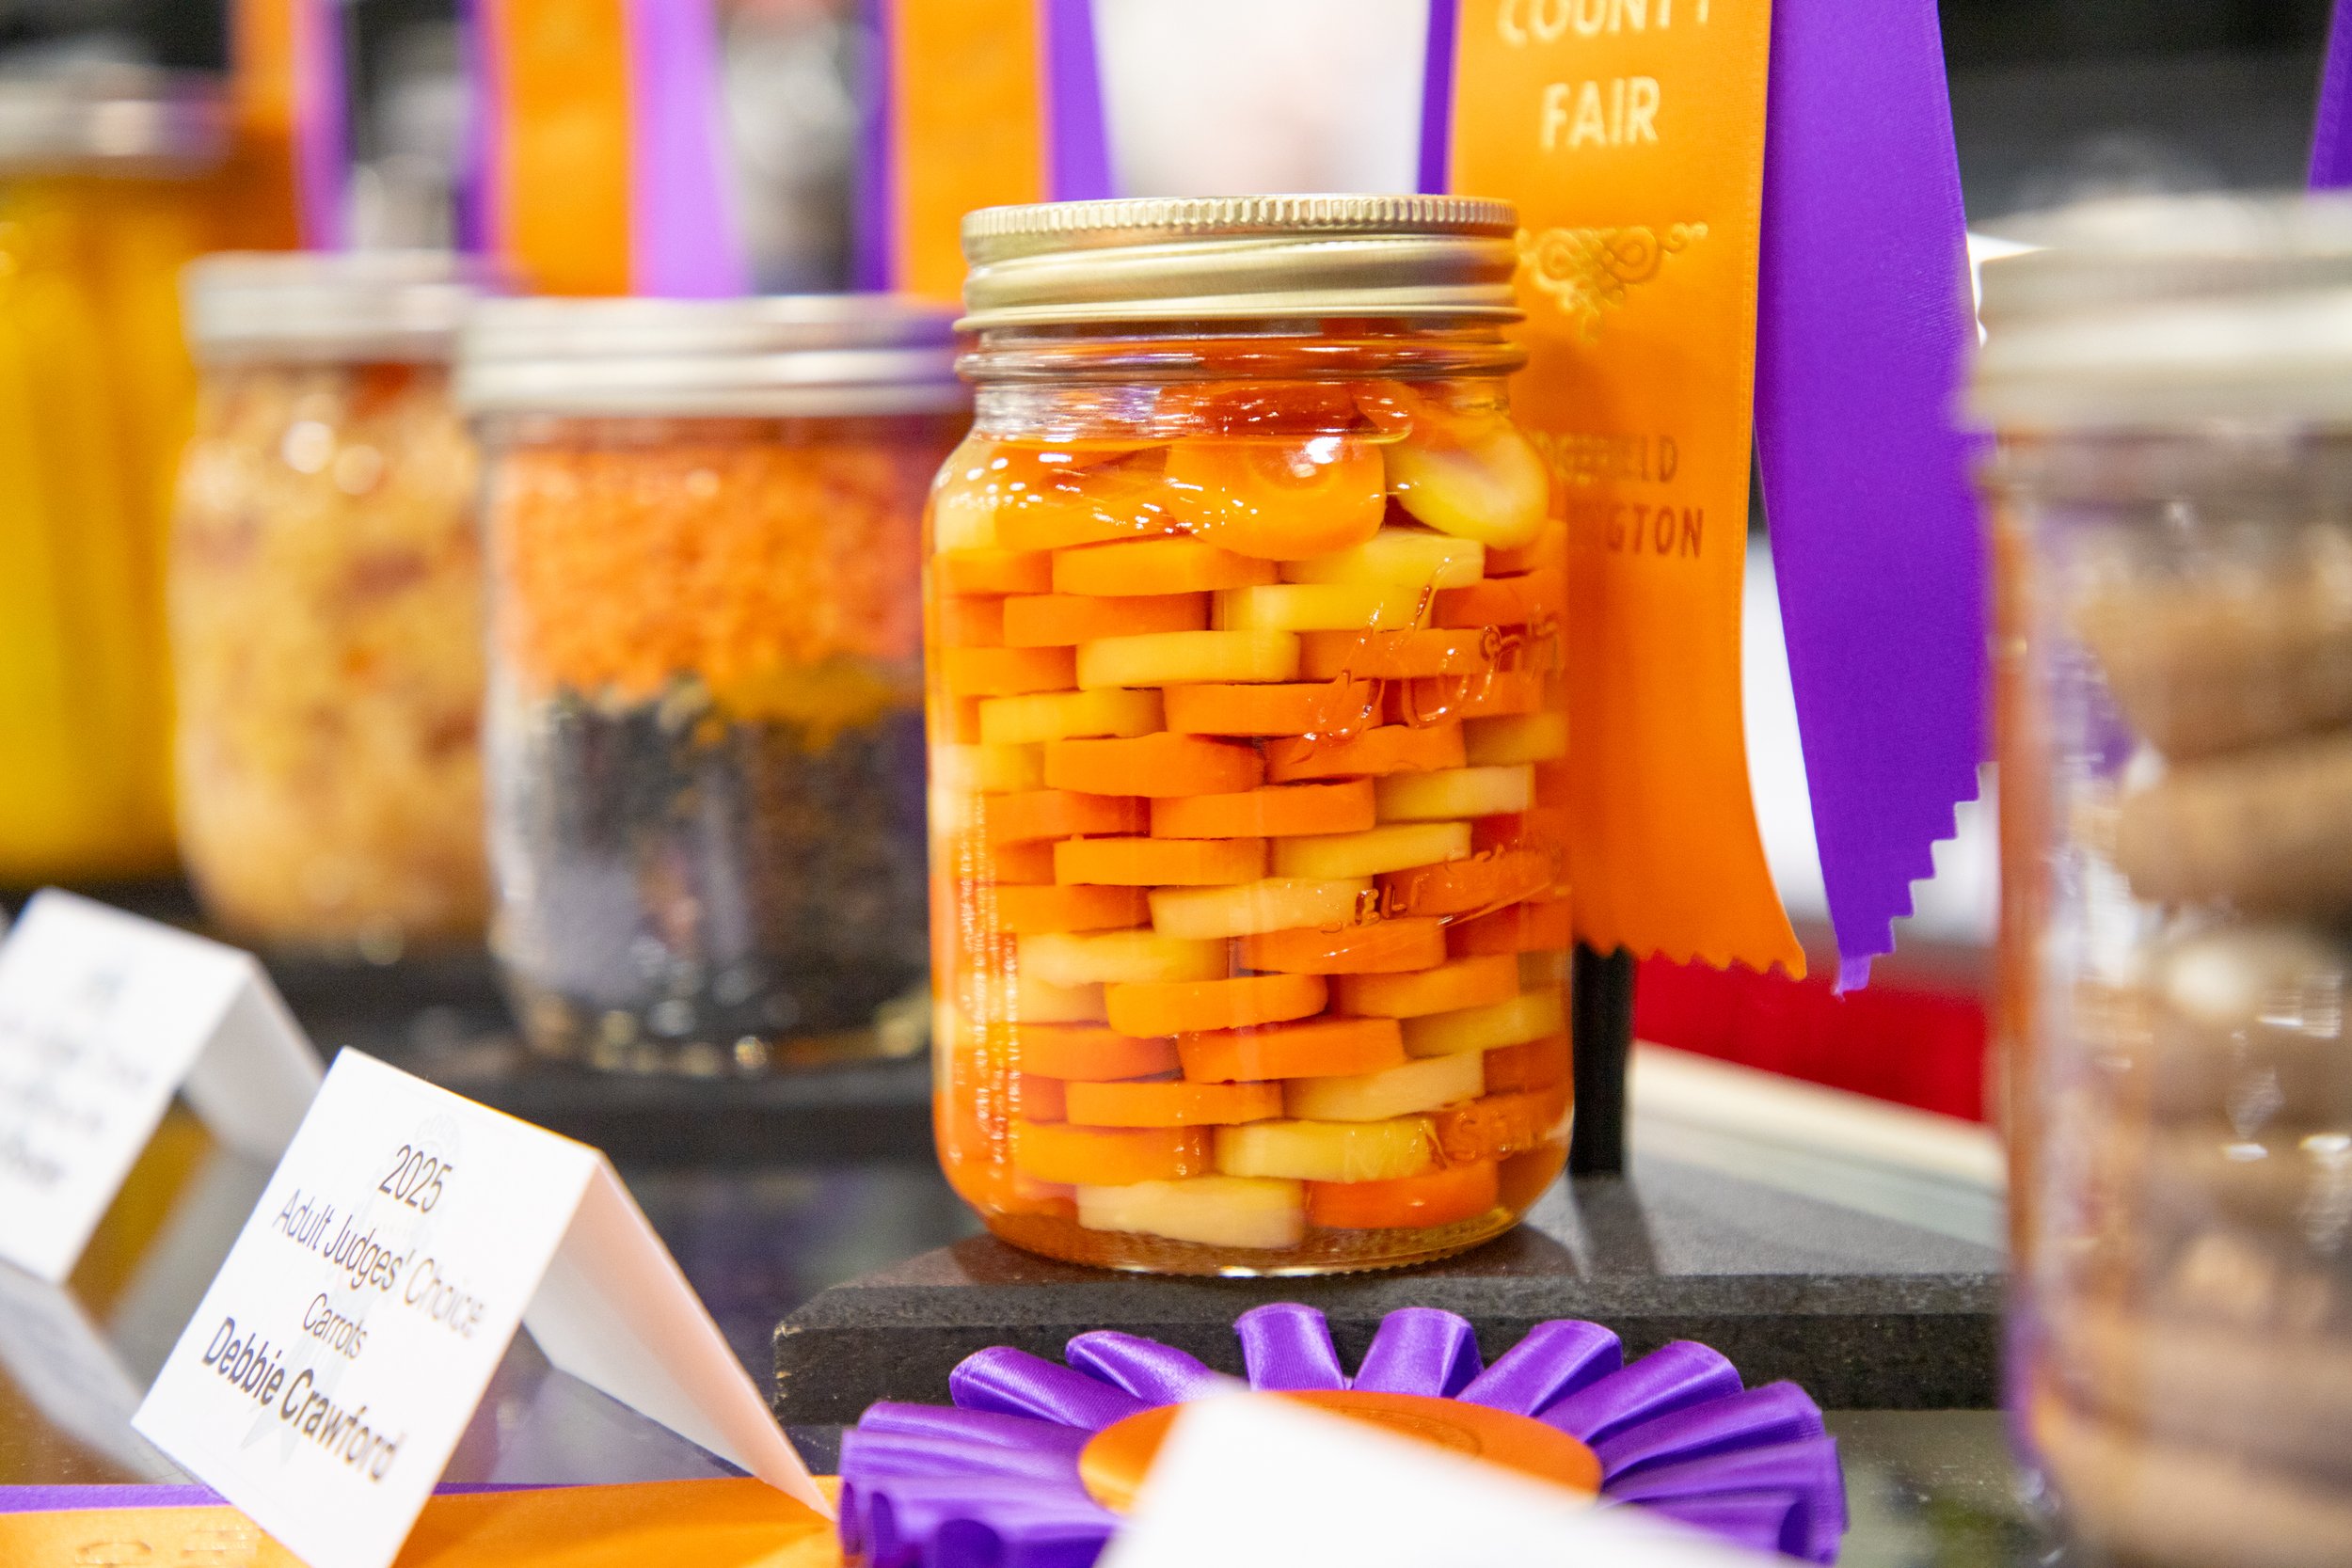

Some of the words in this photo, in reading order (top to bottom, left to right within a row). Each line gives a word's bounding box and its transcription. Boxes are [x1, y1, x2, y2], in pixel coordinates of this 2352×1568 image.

[1540, 75, 1661, 150] FAIR
[378, 1144, 453, 1213] 2025
[272, 1189, 335, 1251] Adult
[323, 1214, 416, 1292] Judges'
[405, 1258, 486, 1339] Choice
[303, 1292, 368, 1360] Carrots
[201, 1316, 285, 1406] Debbie
[280, 1366, 406, 1482] Crawford
